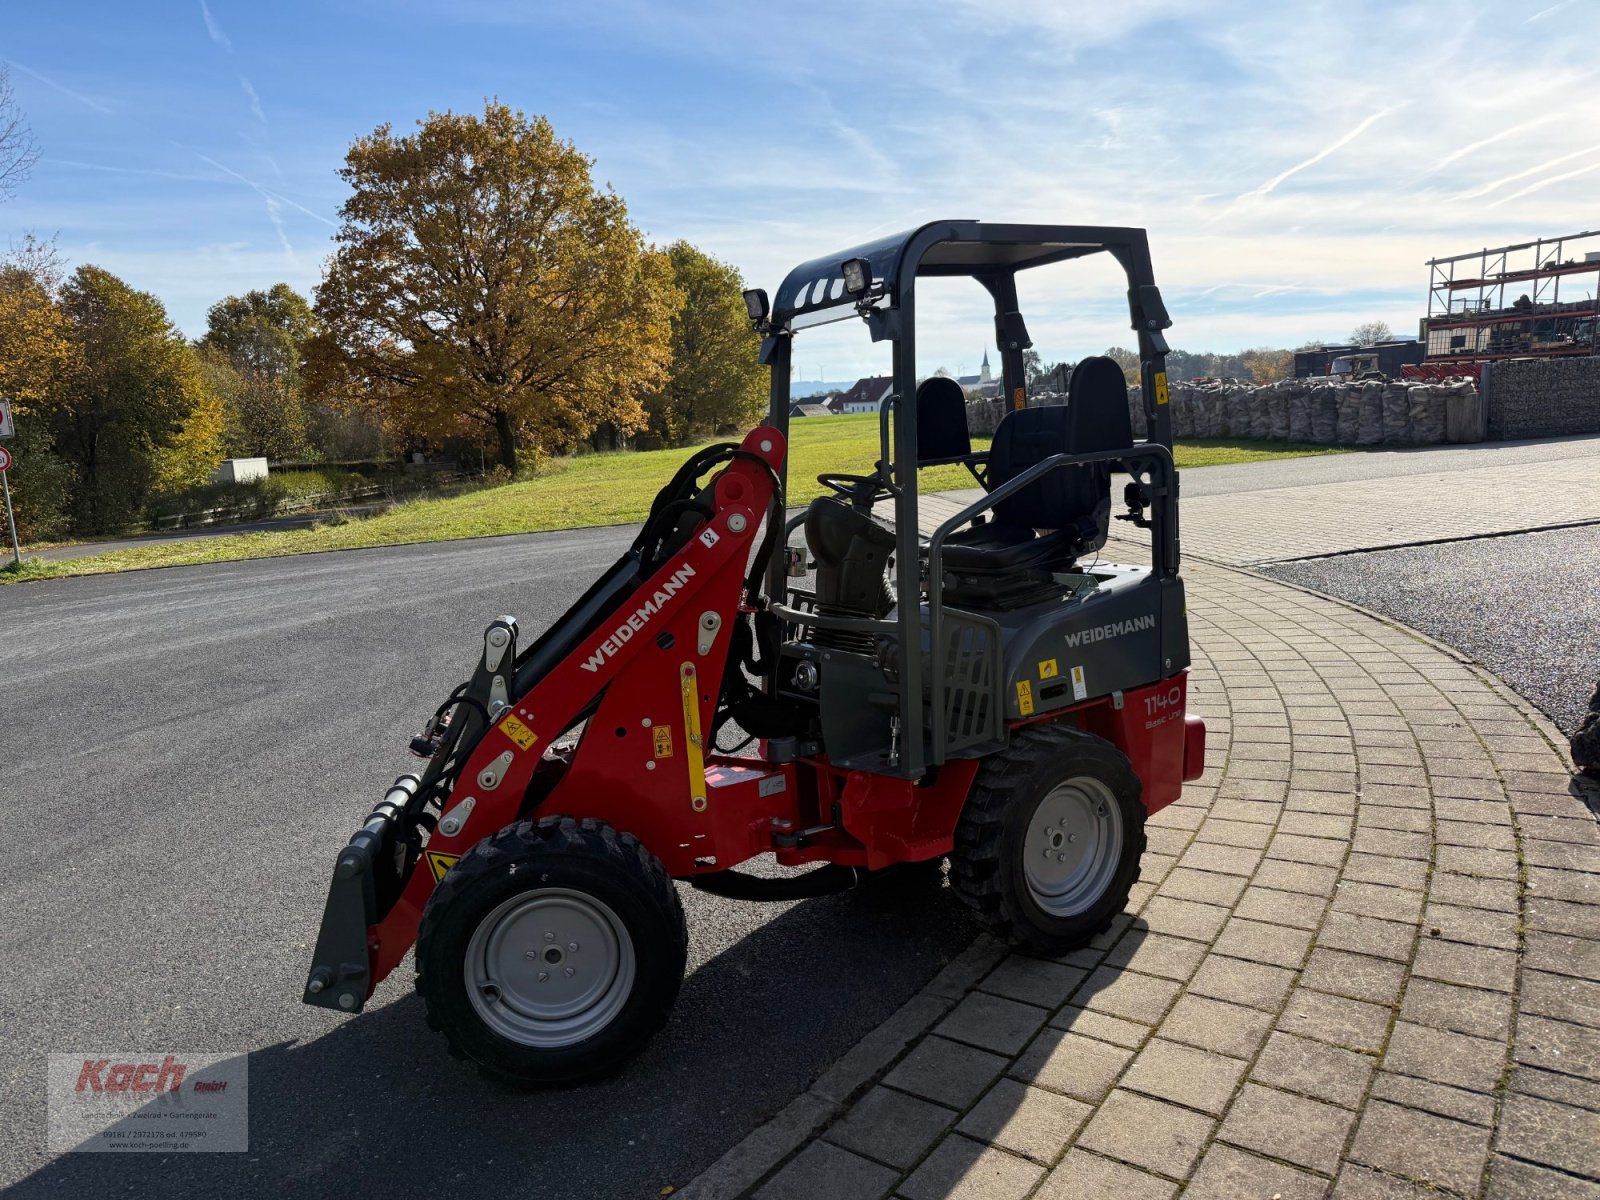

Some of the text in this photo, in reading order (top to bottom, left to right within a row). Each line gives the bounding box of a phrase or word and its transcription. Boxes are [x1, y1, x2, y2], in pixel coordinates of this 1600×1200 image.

[580, 562, 696, 673] WEIDEMANN
[1064, 614, 1156, 648] WEIDEMANN
[1144, 686, 1181, 716] 1140
